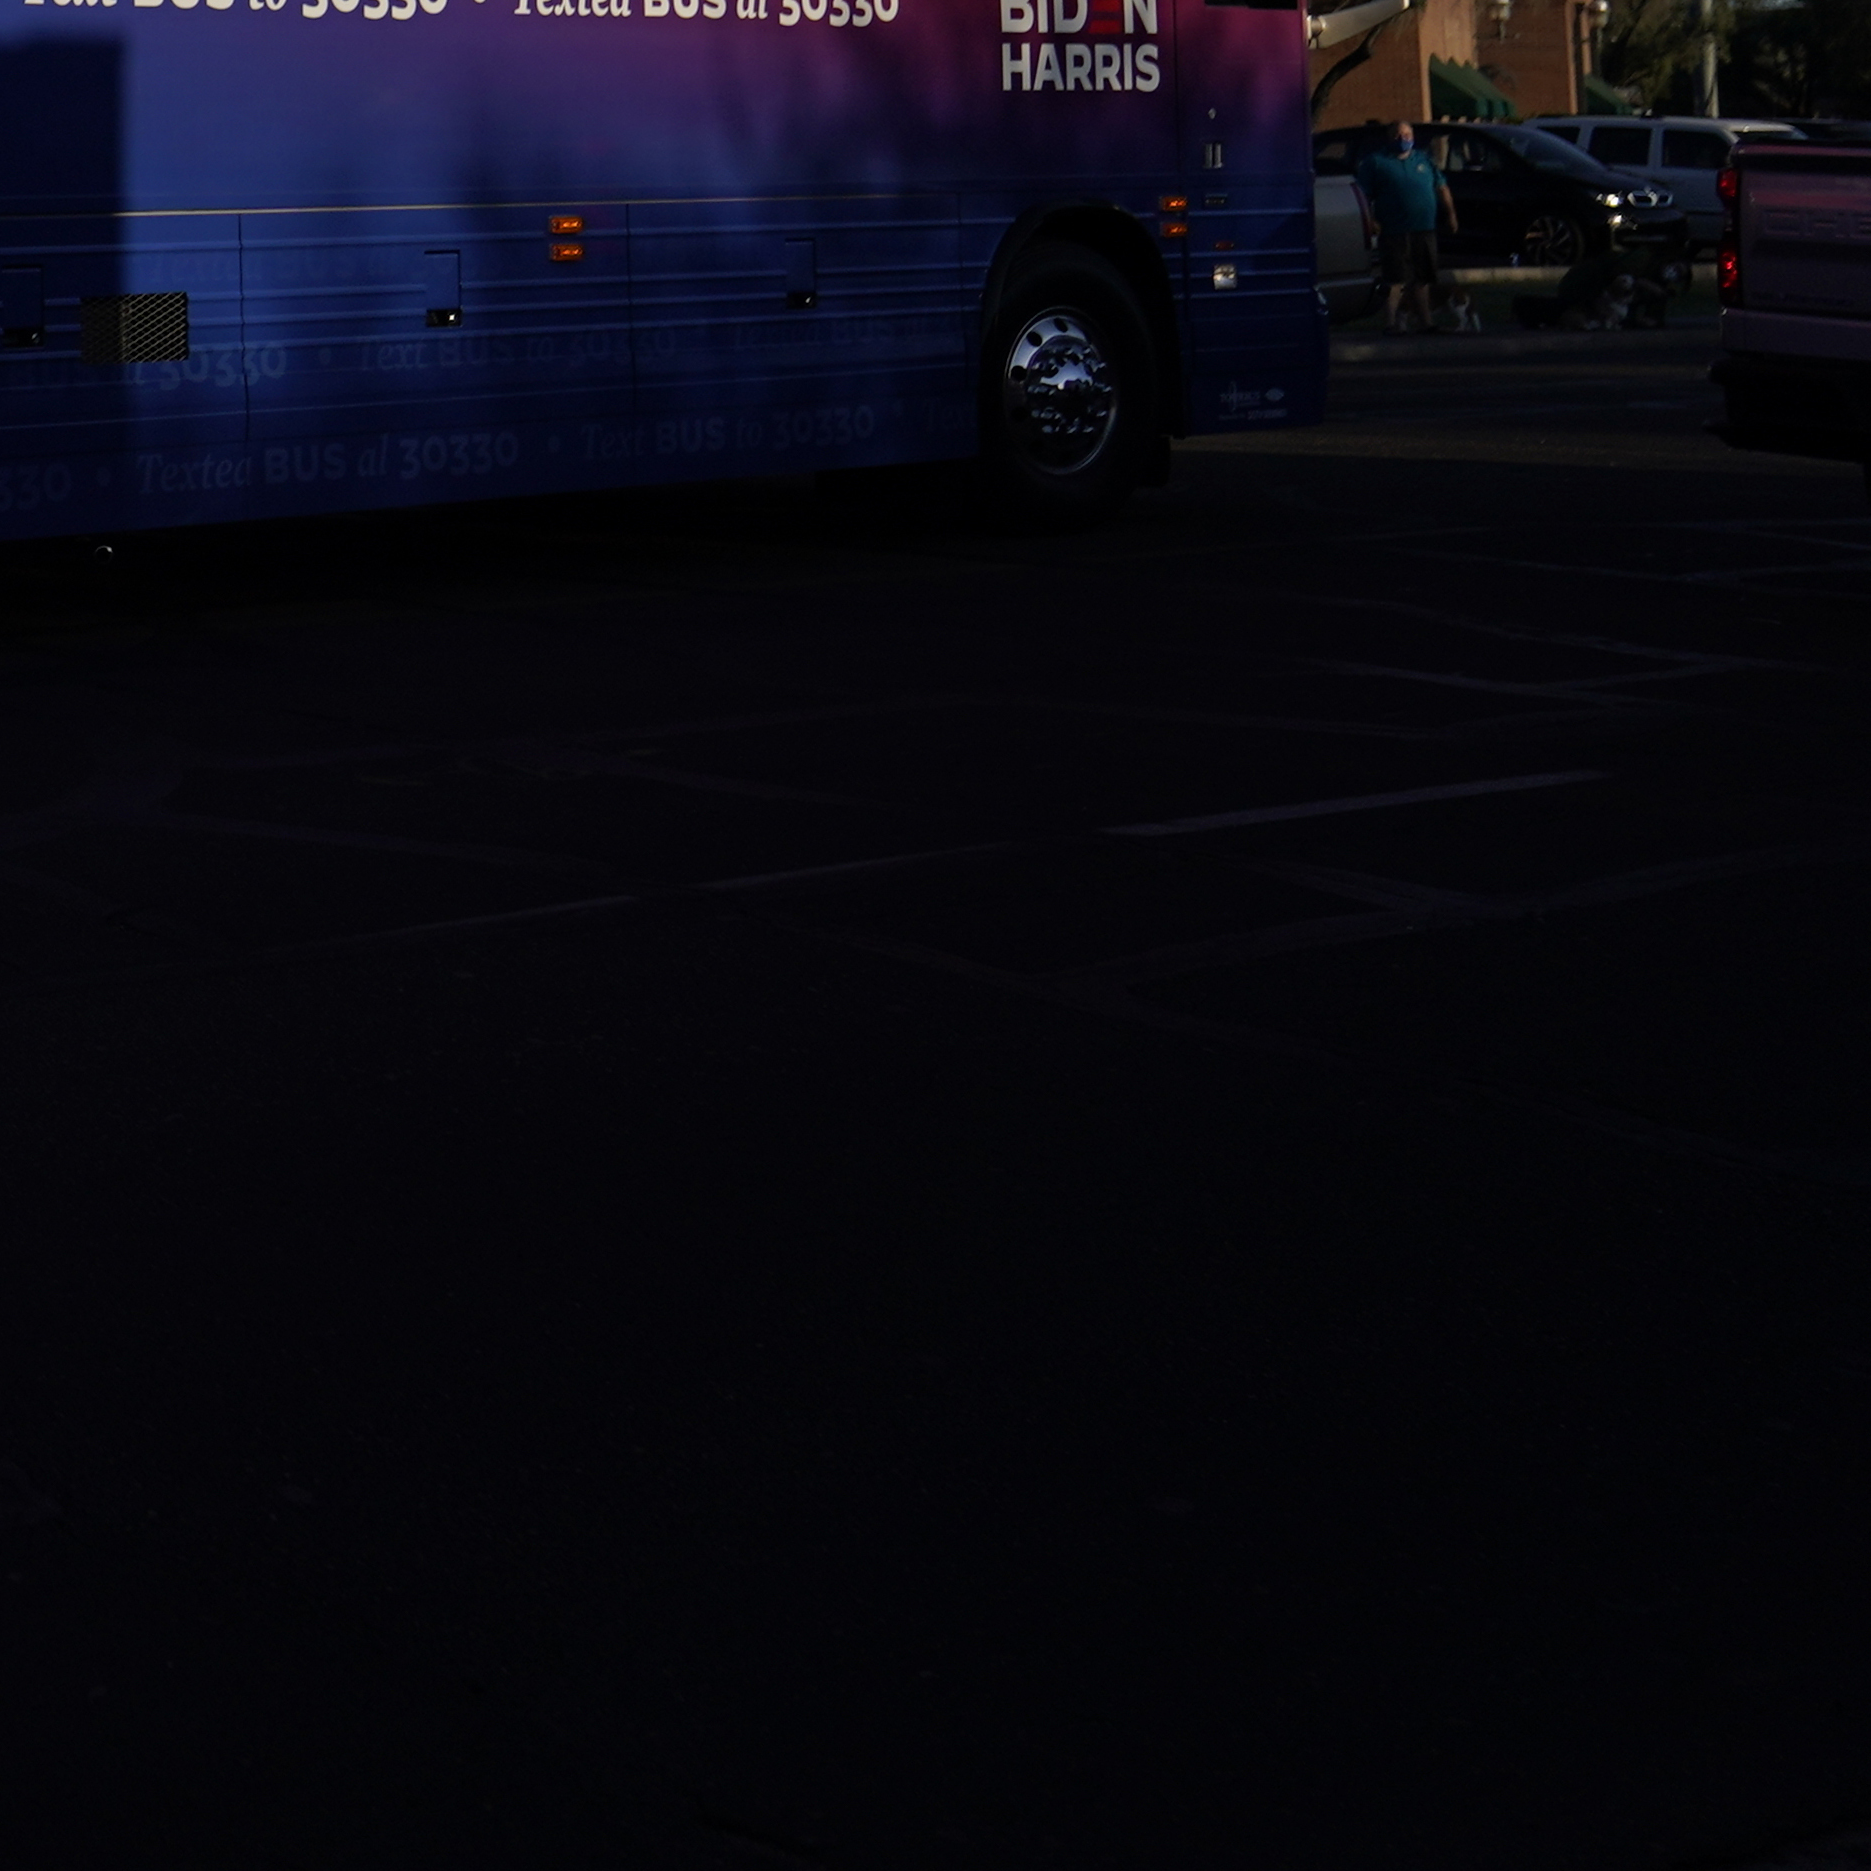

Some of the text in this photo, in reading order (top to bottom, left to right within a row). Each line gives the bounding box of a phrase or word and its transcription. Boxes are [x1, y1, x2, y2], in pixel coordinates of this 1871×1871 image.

[1001, 42, 1161, 93] HARRIS
[263, 442, 347, 485] BUS
[356, 432, 389, 478] al
[398, 429, 520, 480] 30330
[579, 421, 645, 461] Text
[655, 416, 726, 455] BUS
[735, 415, 763, 450] to
[772, 404, 875, 452] 30330
